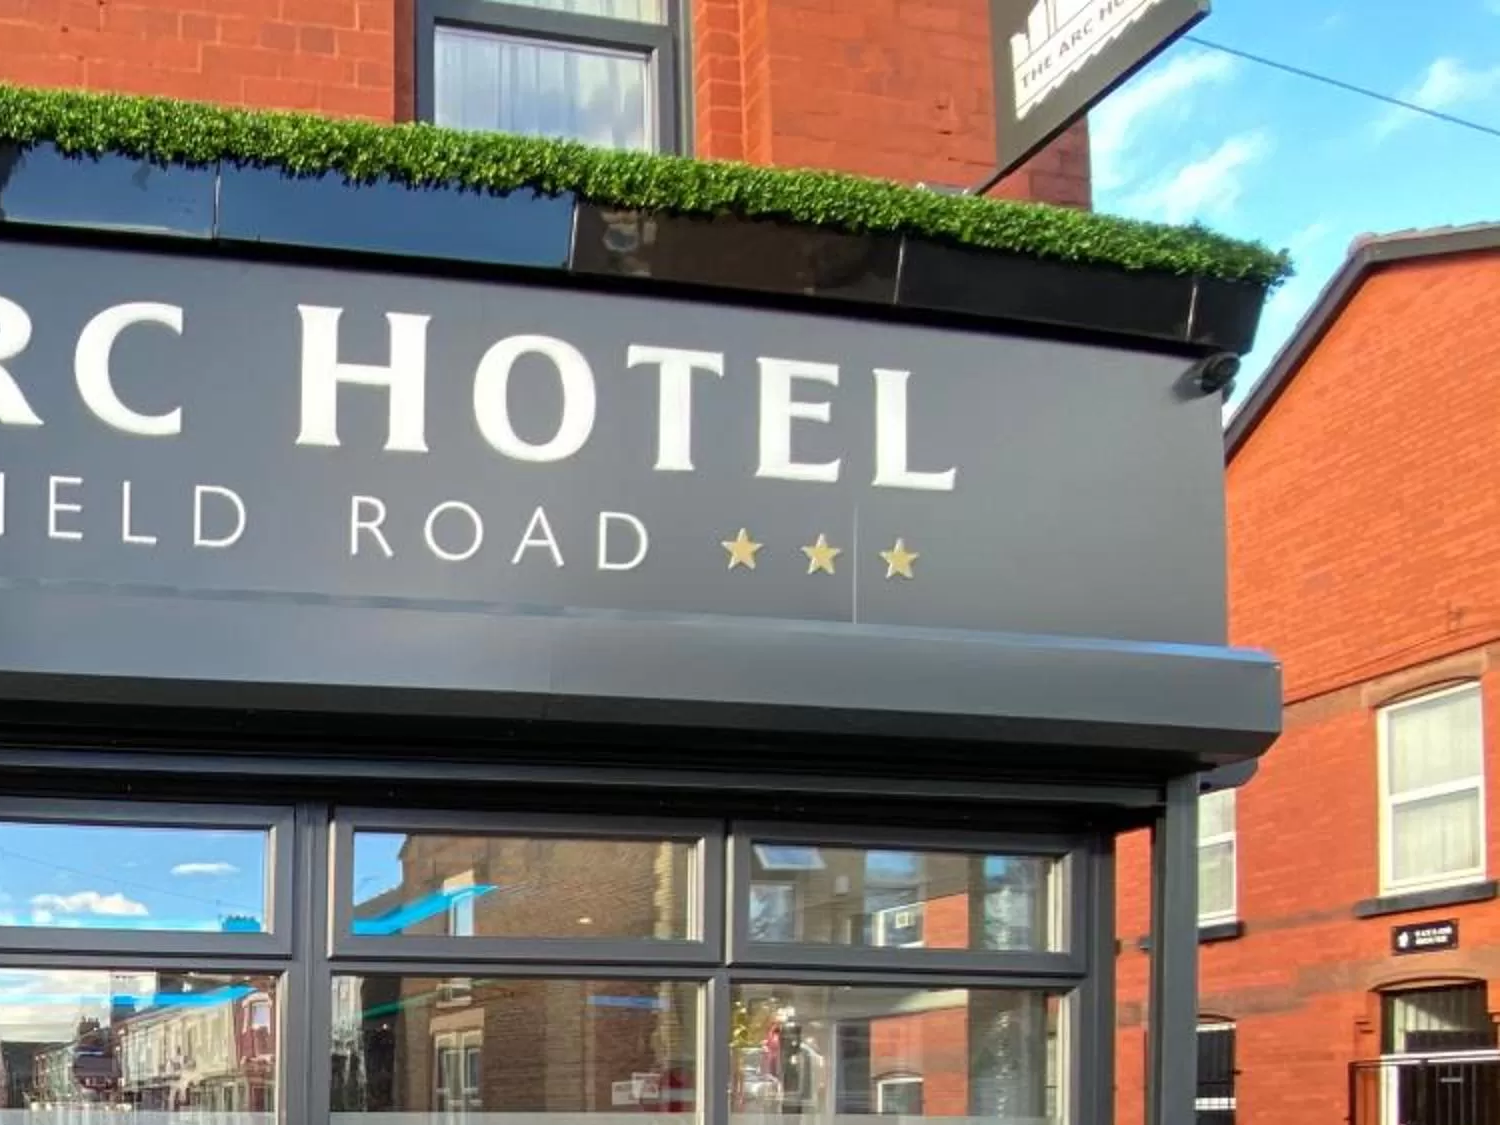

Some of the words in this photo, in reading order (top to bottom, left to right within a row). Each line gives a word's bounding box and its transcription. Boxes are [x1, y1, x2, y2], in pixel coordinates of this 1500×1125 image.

[1059, 18, 1093, 58] ARC
[295, 303, 957, 491] HOTEL
[350, 495, 650, 571] ROAD
